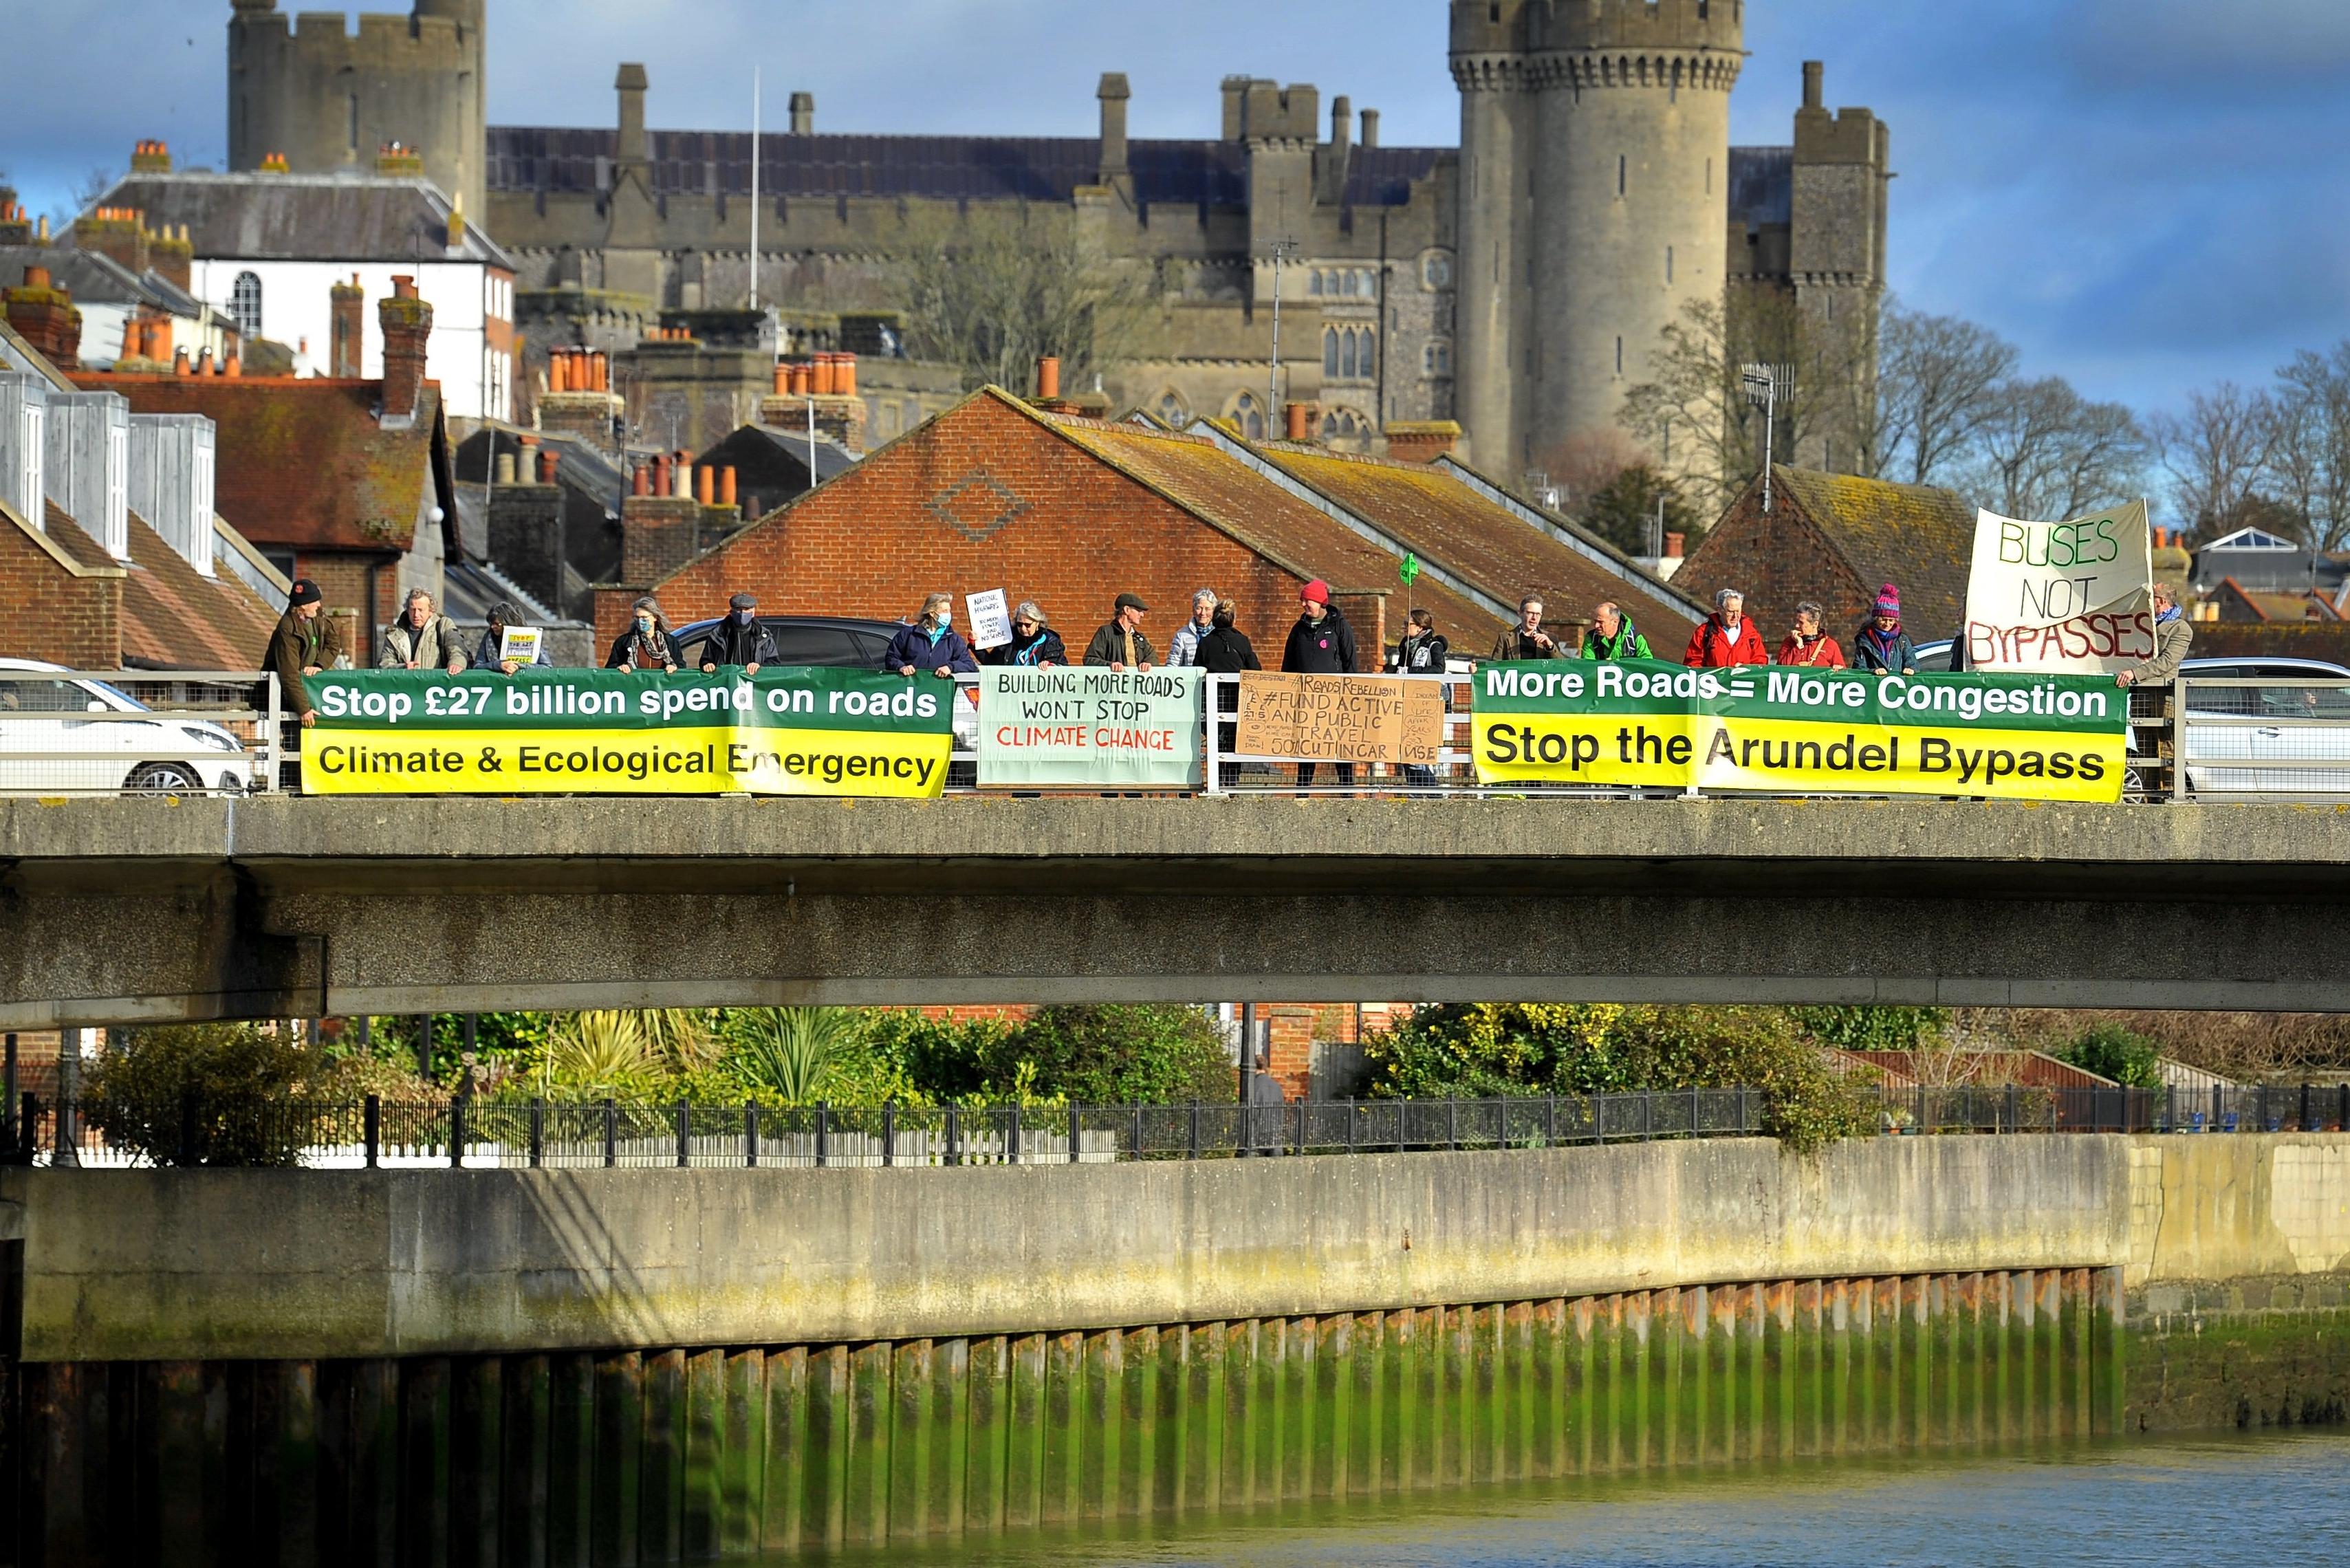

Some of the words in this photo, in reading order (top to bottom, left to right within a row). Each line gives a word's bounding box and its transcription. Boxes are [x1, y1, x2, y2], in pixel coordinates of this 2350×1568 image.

[2000, 520, 2118, 566] BUSES
[2021, 576, 2098, 618] NOT
[1969, 612, 2155, 665] BYPASSES
[318, 686, 411, 723] Stop
[425, 687, 492, 715] £27
[507, 685, 624, 715] billion
[640, 682, 754, 721] spend
[767, 688, 814, 713] on
[829, 686, 937, 717] roads
[999, 674, 1075, 693] BUILDING
[1085, 675, 1129, 695] MORE
[1134, 675, 1185, 699] ROADS
[1487, 670, 1584, 697] More
[1598, 666, 1719, 699] Roads
[1730, 680, 1754, 698] =
[1767, 672, 1865, 707] More
[1878, 675, 2106, 720] Congestion
[1023, 701, 1085, 719] WON'T
[1096, 700, 1149, 721] STOP
[1263, 691, 1331, 710] #FUND
[1336, 697, 1403, 716] ACTIVE
[1272, 709, 1308, 723] AND
[1316, 711, 1382, 729] PUBLIC
[997, 726, 1087, 747] CLIMATE
[1095, 728, 1174, 750] CHANGE
[1296, 726, 1371, 743] TRAVEL
[1300, 739, 1334, 756] CUT
[1357, 744, 1388, 759] CAR
[1404, 745, 1435, 761] USE
[319, 745, 464, 773] Climate
[479, 746, 503, 772] &
[520, 745, 714, 781] Ecological
[728, 744, 935, 787] Emergency
[1486, 723, 1599, 771] Stop
[1616, 726, 1693, 764] the
[1706, 728, 1898, 772] Arundel
[1919, 737, 2104, 785] Bypass
